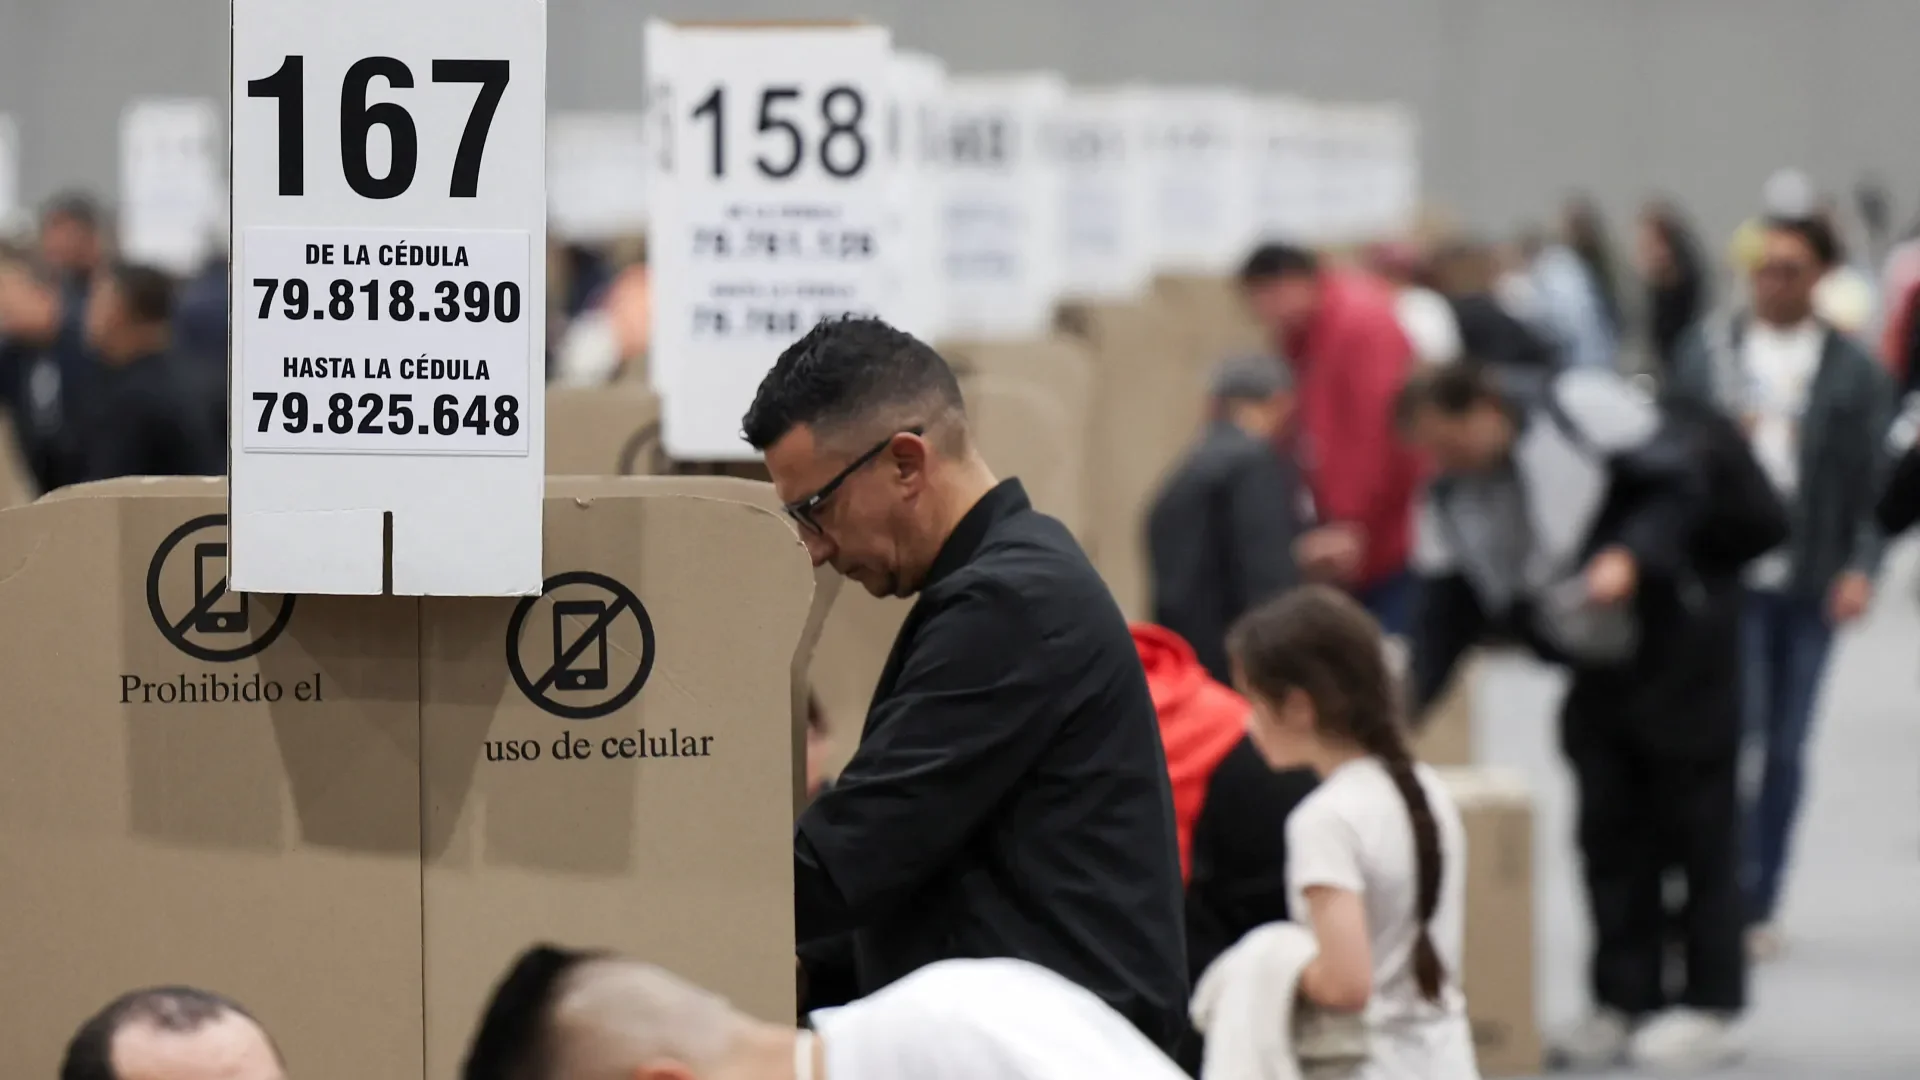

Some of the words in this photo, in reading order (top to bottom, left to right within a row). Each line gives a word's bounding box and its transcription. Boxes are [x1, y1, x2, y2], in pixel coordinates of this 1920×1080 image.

[247, 55, 510, 200] 167
[691, 84, 869, 181] 158
[306, 244, 333, 264] DE
[344, 245, 370, 265] LA
[379, 240, 468, 266] CÉDULA
[253, 278, 521, 324] 79.818.390
[284, 357, 355, 378] HASTA
[365, 359, 391, 378] LA
[400, 354, 489, 380] CÉDULA
[252, 391, 520, 437] 79.825.648
[120, 673, 284, 703] Prohibido
[294, 672, 322, 702] el
[484, 741, 540, 761] uso
[552, 731, 591, 760] de
[600, 728, 714, 760] celular
